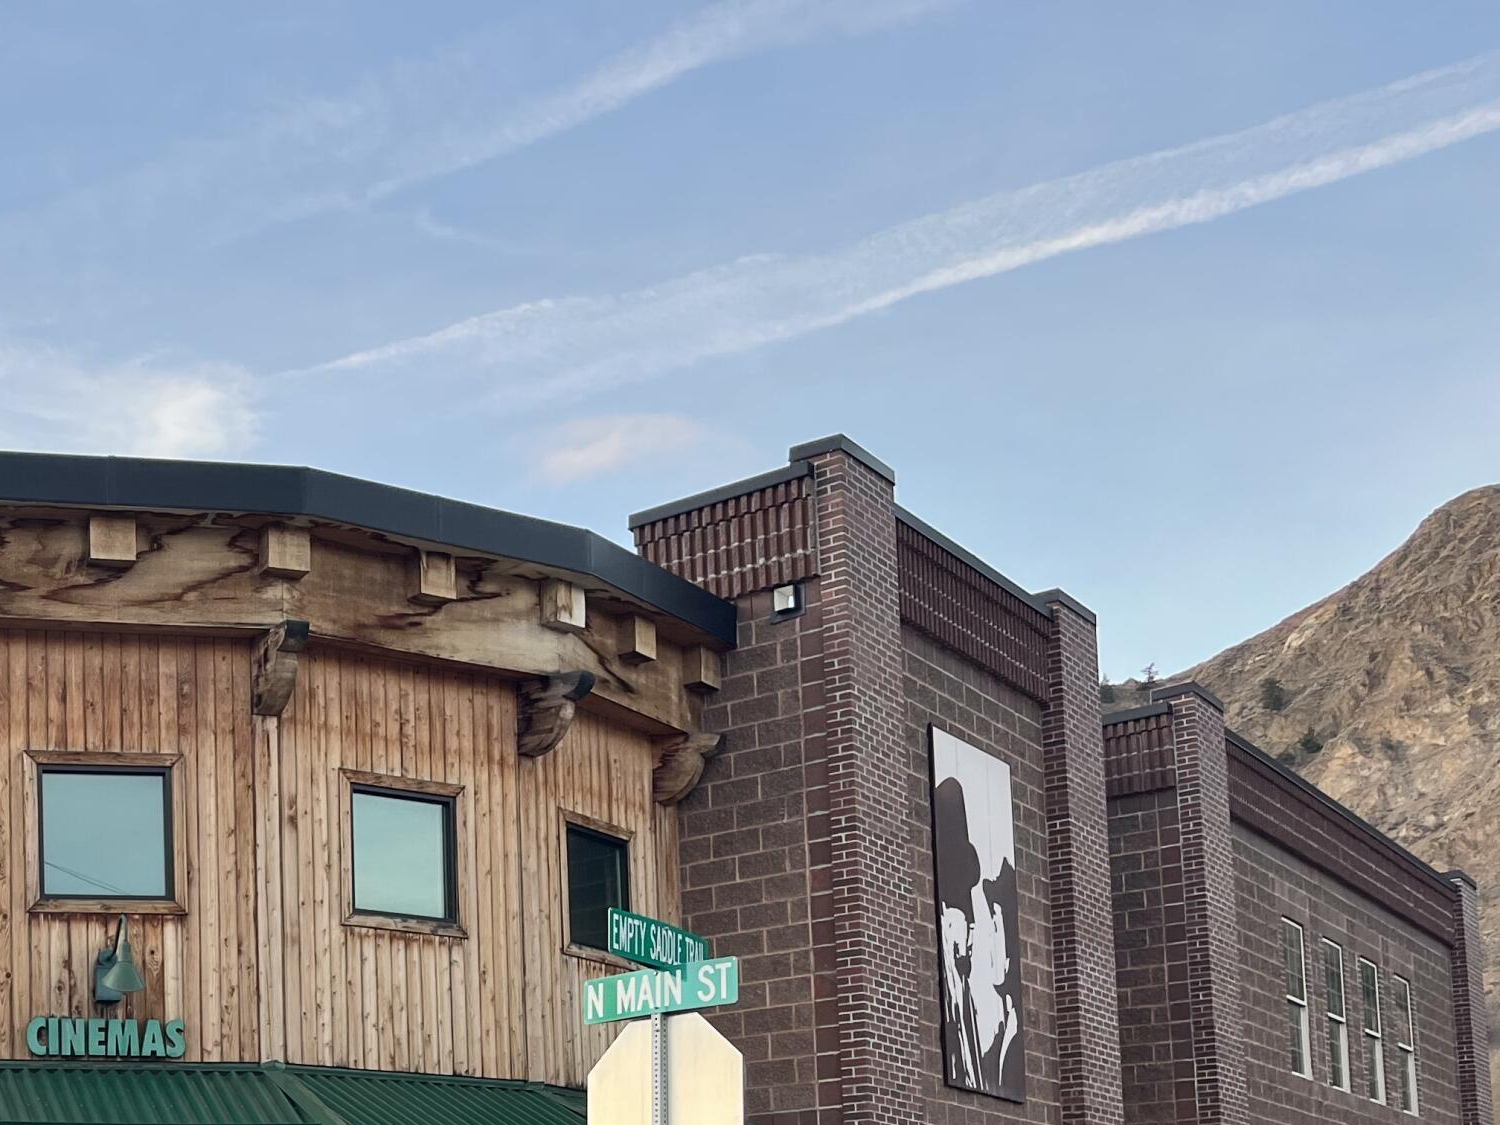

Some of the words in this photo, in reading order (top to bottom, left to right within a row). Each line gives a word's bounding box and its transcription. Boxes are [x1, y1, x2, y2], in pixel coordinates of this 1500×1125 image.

[612, 913, 647, 957] EMPTY
[650, 923, 682, 966] SADDLE
[685, 937, 704, 964] TRAIL
[587, 982, 604, 1020] N
[616, 969, 682, 1015] MAIN
[697, 962, 732, 1002] ST
[26, 1015, 186, 1057] CINEMAS
